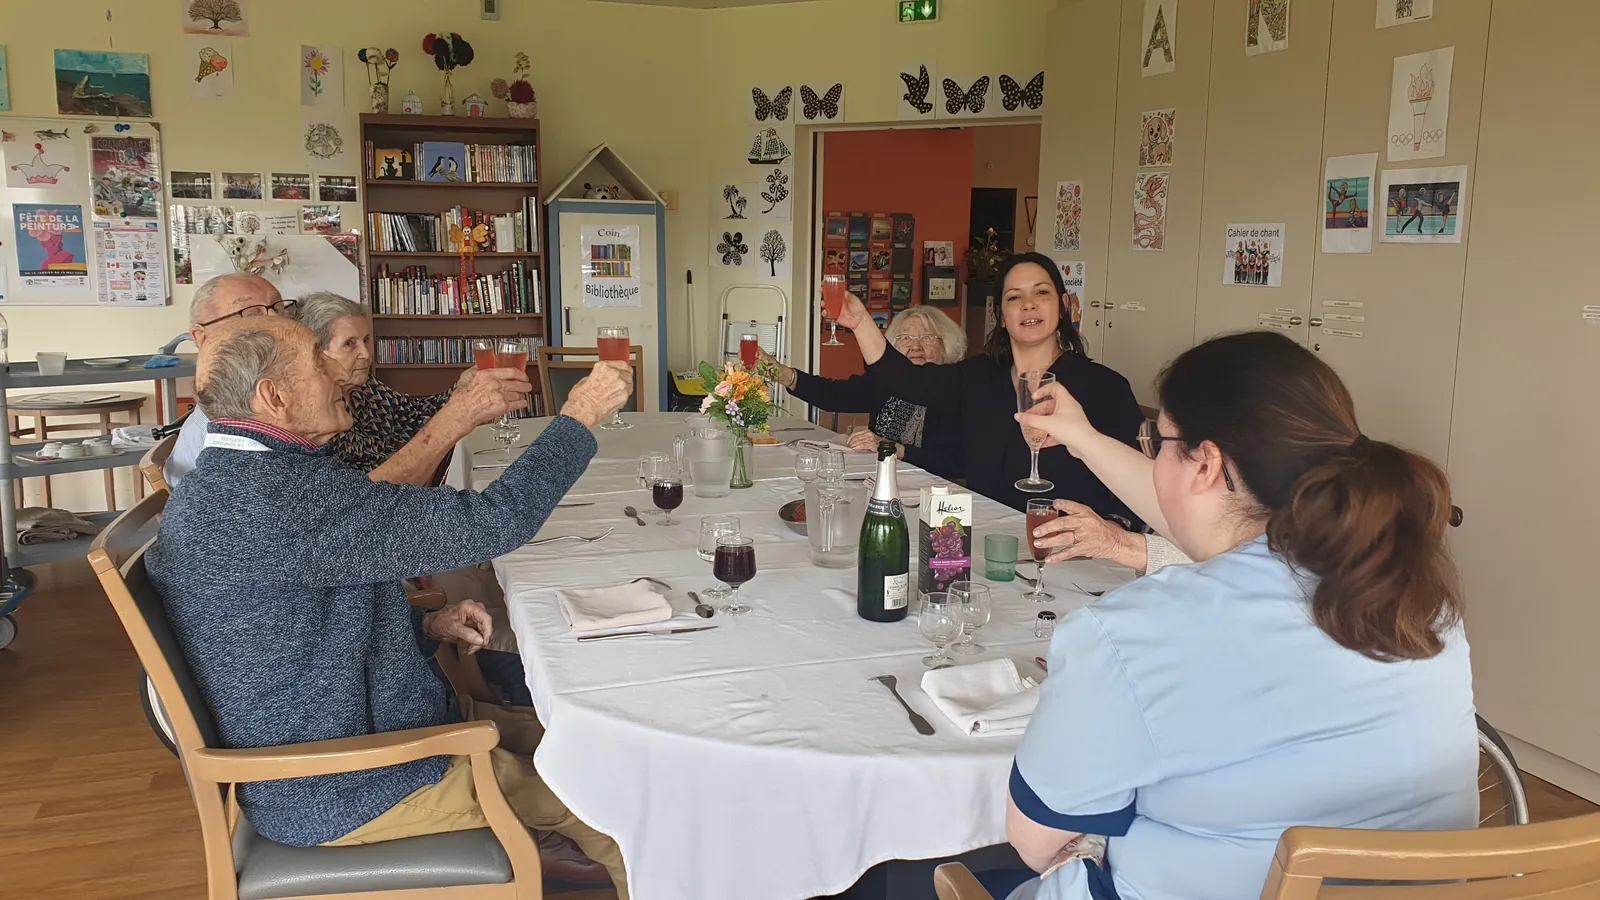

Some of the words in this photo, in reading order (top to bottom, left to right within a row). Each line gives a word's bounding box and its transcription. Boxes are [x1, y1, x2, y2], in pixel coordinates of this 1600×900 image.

[1142, 4, 1174, 68] A
[19, 212, 47, 222] FÊTE
[65, 215, 79, 223] LA
[597, 228, 620, 238] Coin
[1227, 228, 1249, 238] Cahier
[1250, 228, 1259, 238] de
[1260, 228, 1280, 238] chant
[1064, 277, 1083, 287] société
[585, 284, 639, 300] Bibliothèque
